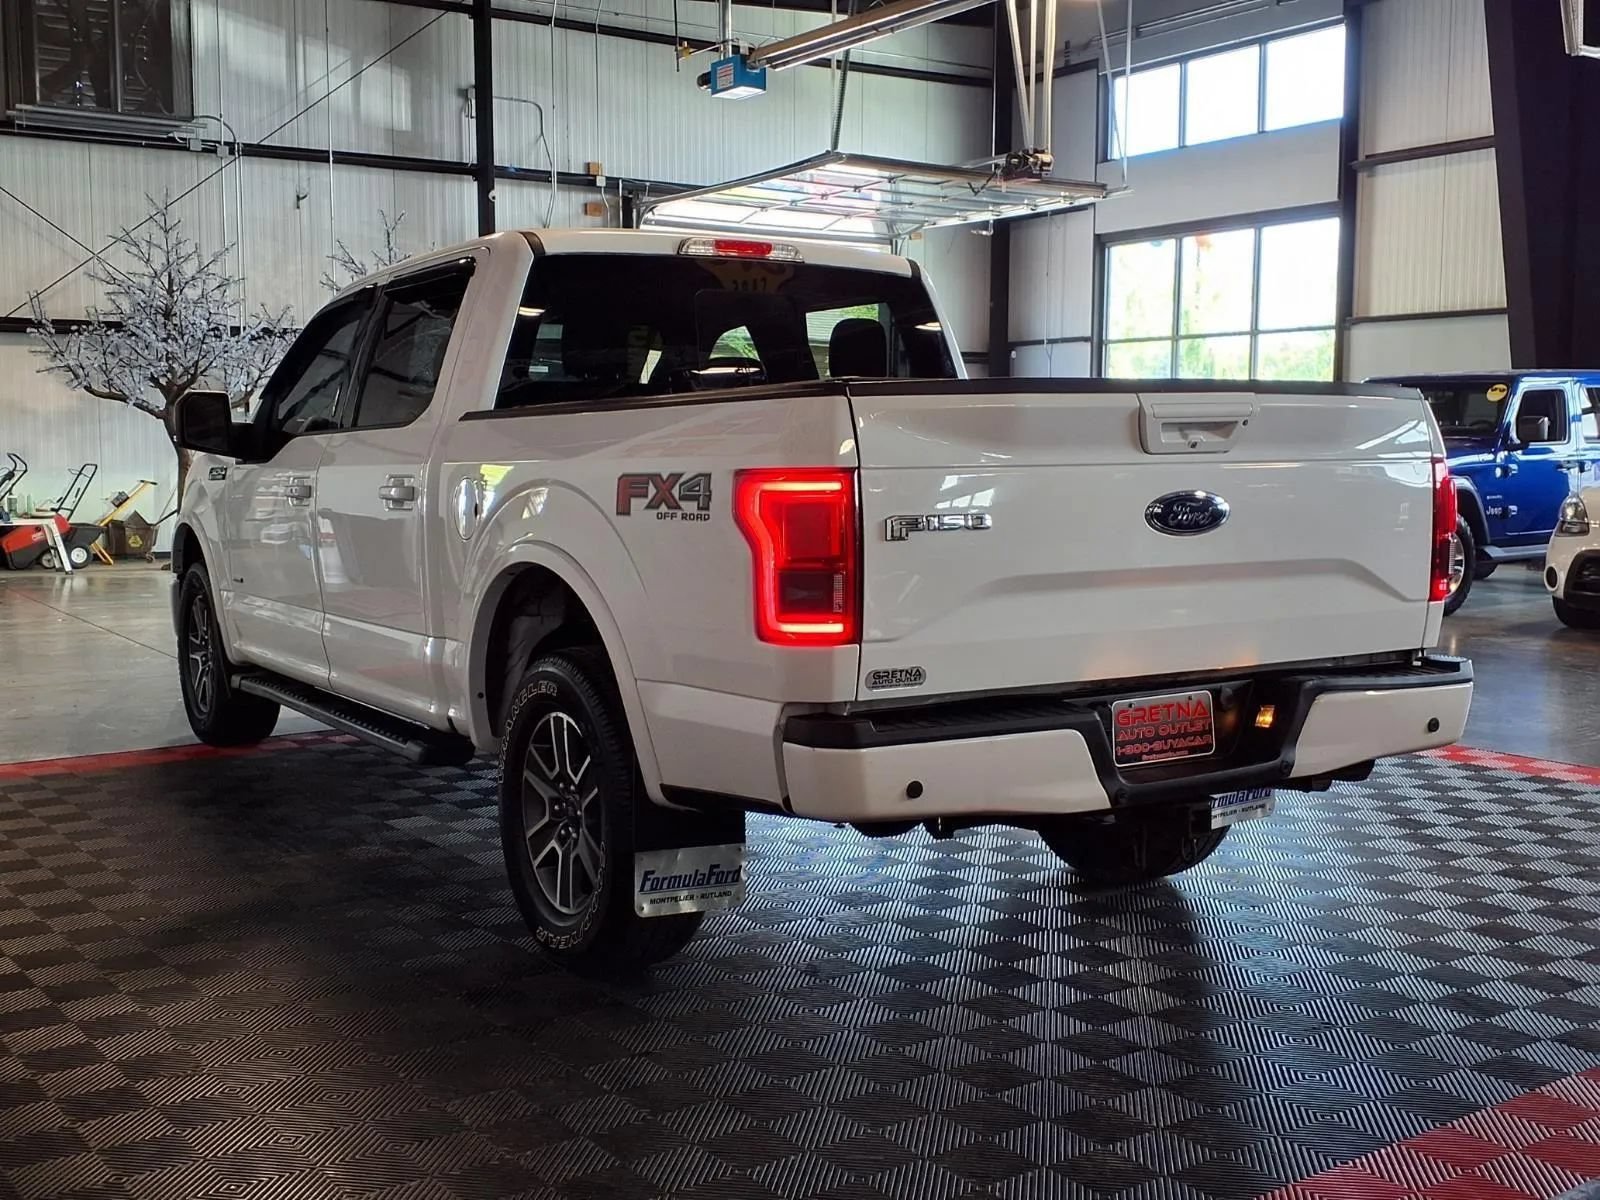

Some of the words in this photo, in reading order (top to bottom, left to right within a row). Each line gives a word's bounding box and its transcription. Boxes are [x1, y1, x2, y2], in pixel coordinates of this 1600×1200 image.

[616, 472, 712, 516] FX4
[656, 511, 678, 520] OFF
[681, 512, 710, 522] ROAD
[872, 668, 922, 680] GRETNA
[1116, 699, 1209, 728] GRETNA
[1116, 726, 1156, 742] AUTO
[1158, 718, 1212, 737] OUTLET
[1116, 734, 1212, 757] 1-800-BUYACAR
[649, 894, 695, 905] MONTPELIER
[700, 890, 733, 900] RUTLAND
